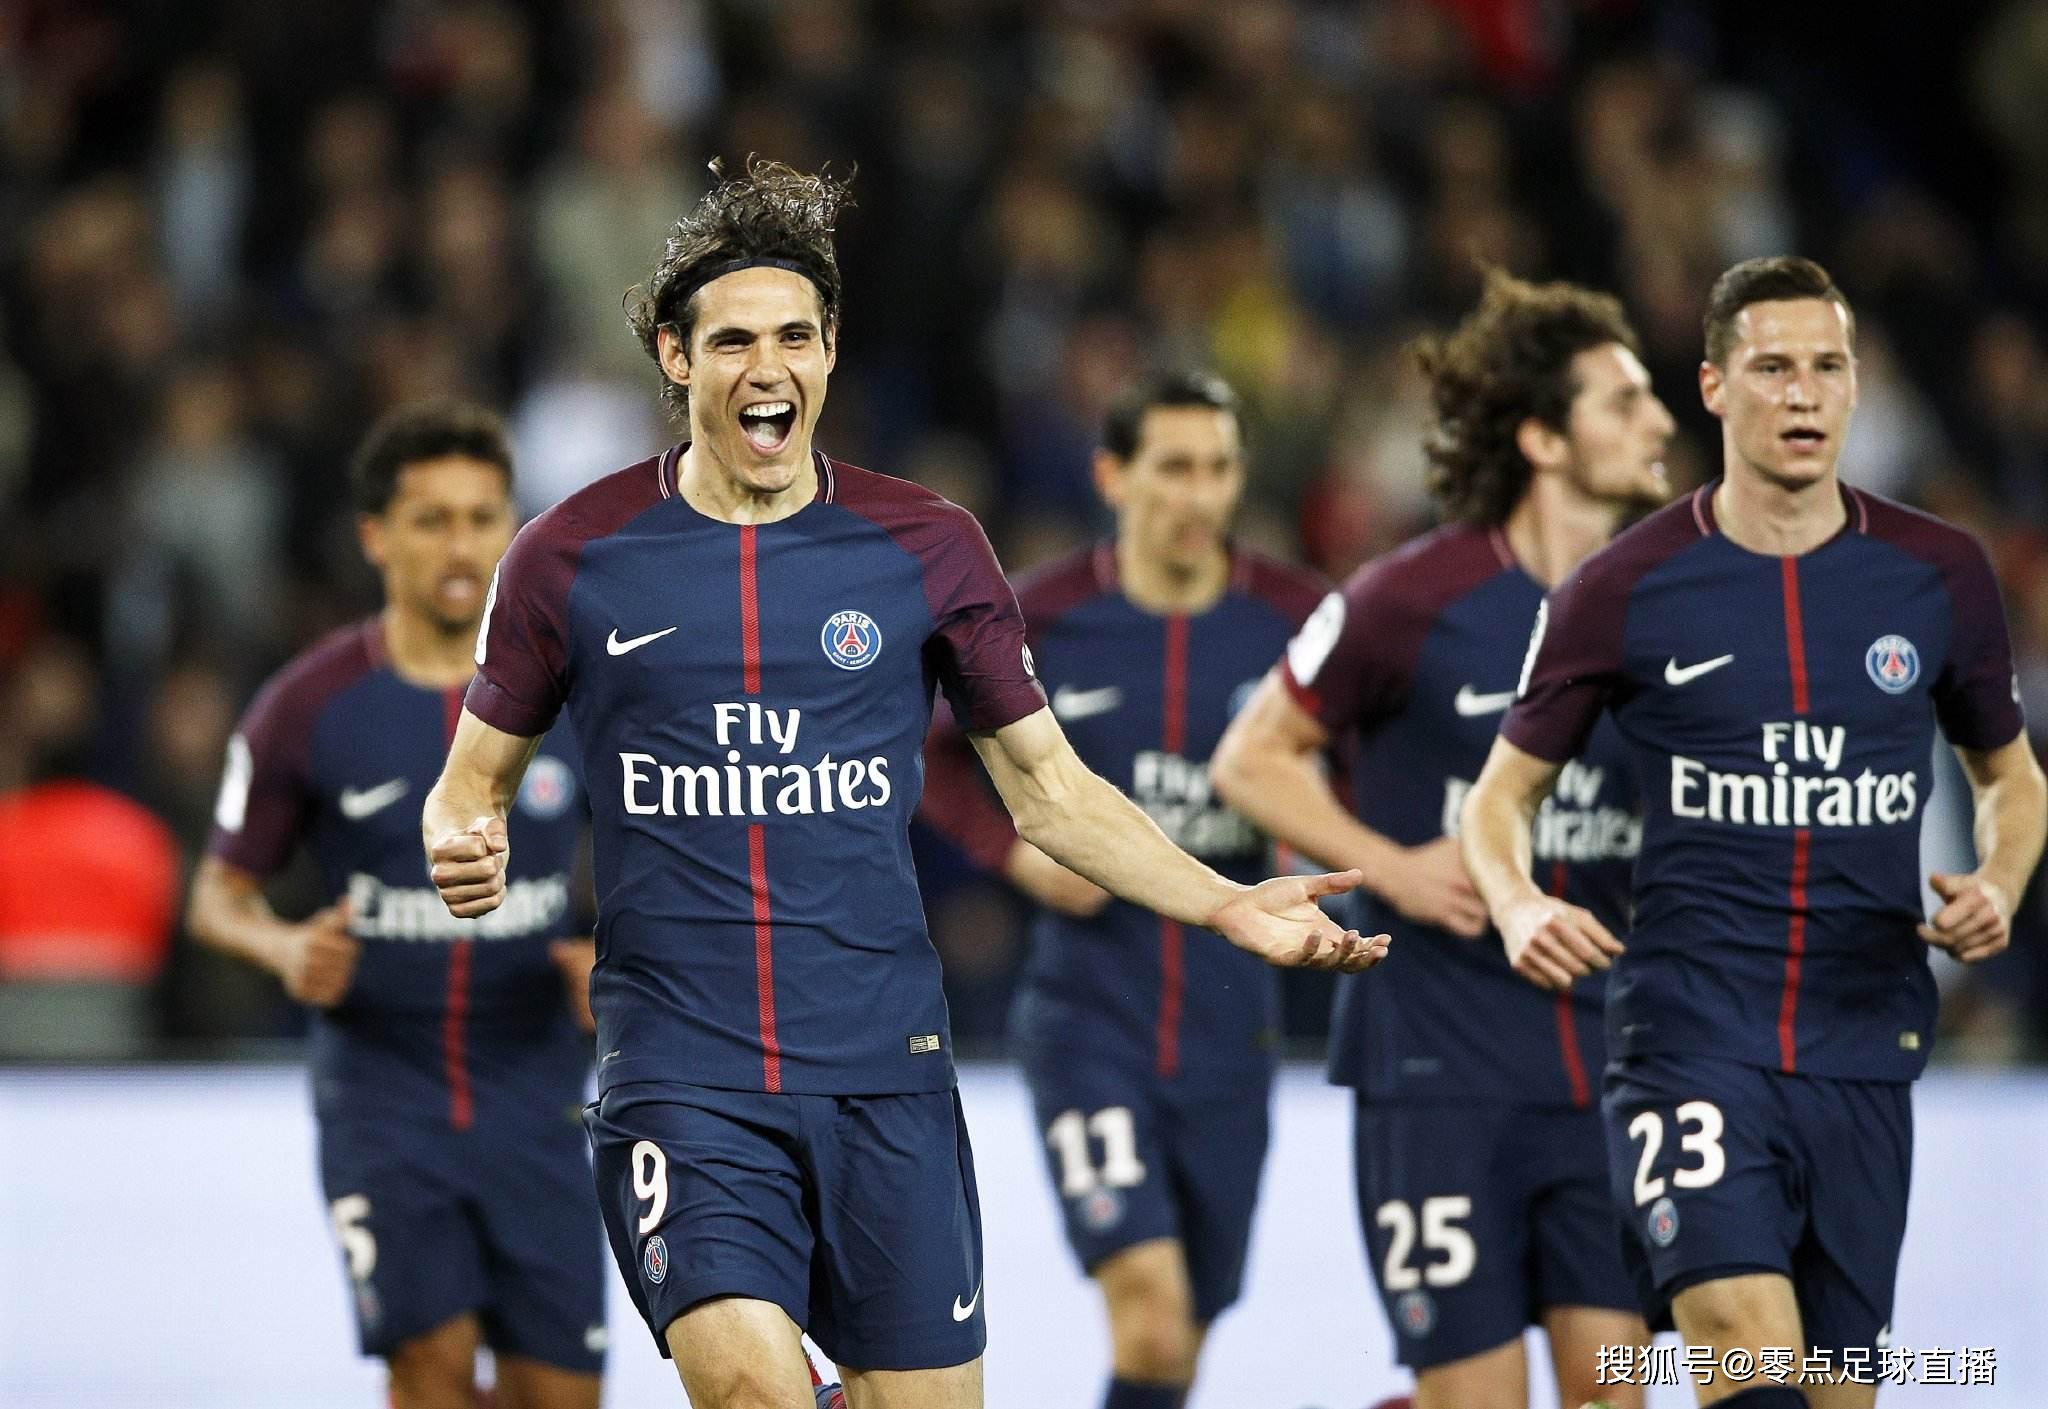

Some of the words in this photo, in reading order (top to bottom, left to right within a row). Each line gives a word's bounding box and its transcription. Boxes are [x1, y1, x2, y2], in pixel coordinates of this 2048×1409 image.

[831, 613, 871, 628] PARIS
[713, 702, 801, 754] Fly
[1762, 720, 1846, 771] Fly
[618, 750, 891, 816] Emirates
[1556, 757, 1605, 808] ly
[1671, 755, 1917, 826] Emirates
[1048, 1107, 1147, 1198] 11
[1628, 1100, 1726, 1207] 23
[631, 1140, 669, 1234] 9
[1376, 1195, 1477, 1292] 25
